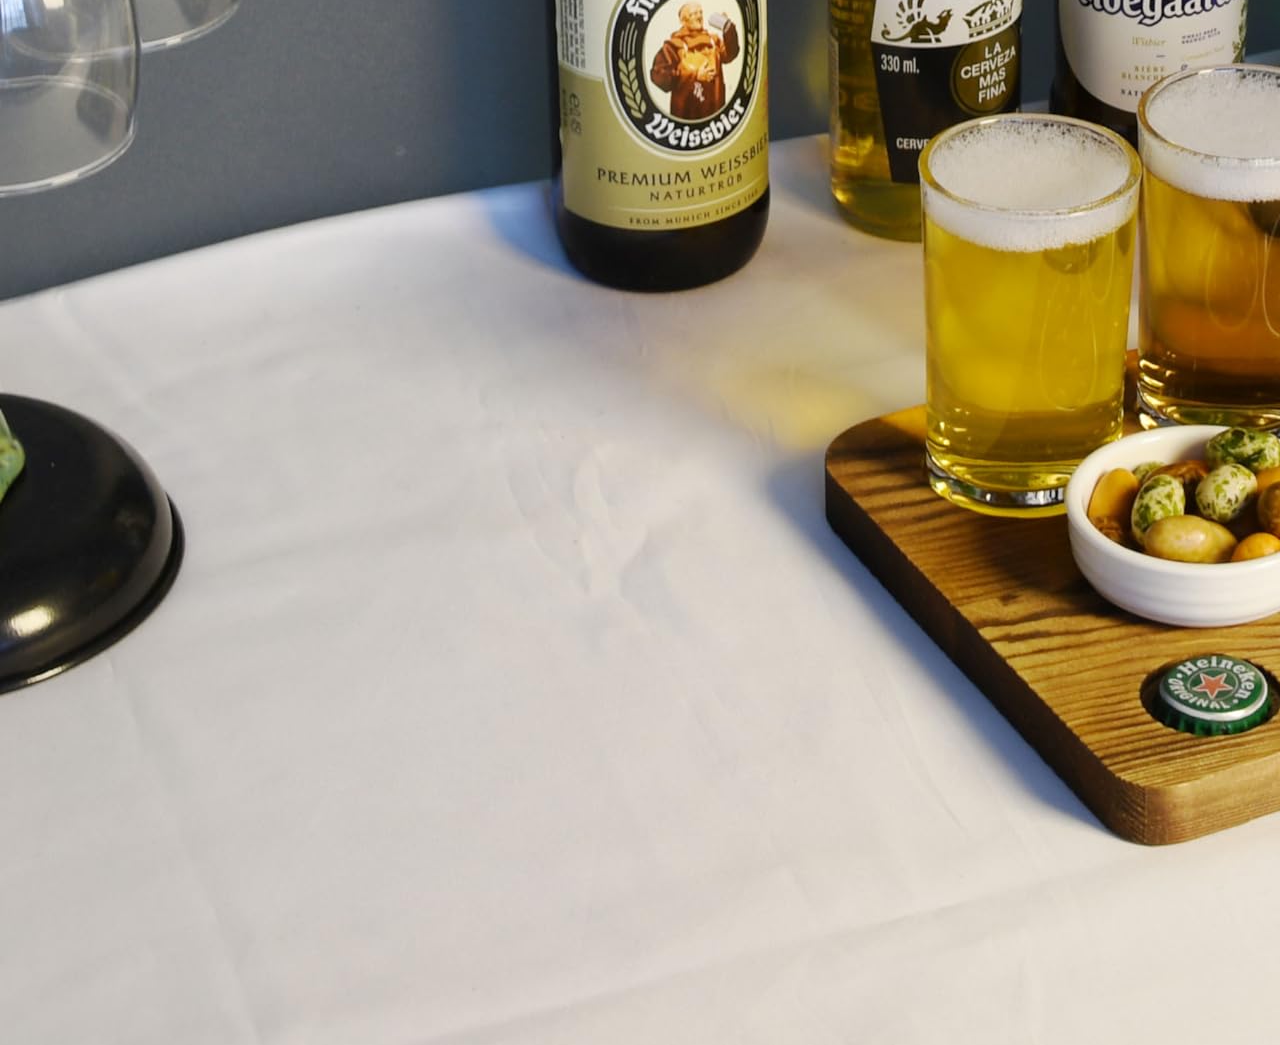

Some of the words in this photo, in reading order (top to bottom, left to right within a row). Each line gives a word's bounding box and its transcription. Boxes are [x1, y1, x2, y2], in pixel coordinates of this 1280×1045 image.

[985, 42, 1002, 59] LA
[880, 54, 901, 73] 330
[903, 56, 920, 74] ml.
[961, 47, 1017, 80] CERVEZA
[979, 68, 1006, 89] MAS
[978, 84, 1007, 104] FINA
[645, 97, 746, 148] Weissbier
[896, 137, 930, 150] CERVE
[597, 167, 692, 187] PREMIUM
[649, 173, 744, 203] NATURTRÜB
[629, 215, 660, 226] FROM
[665, 211, 711, 225] MUNICH
[715, 200, 742, 216] SINCE
[1176, 655, 1256, 700] Heineken
[1167, 677, 1232, 710] ORIGINAL
